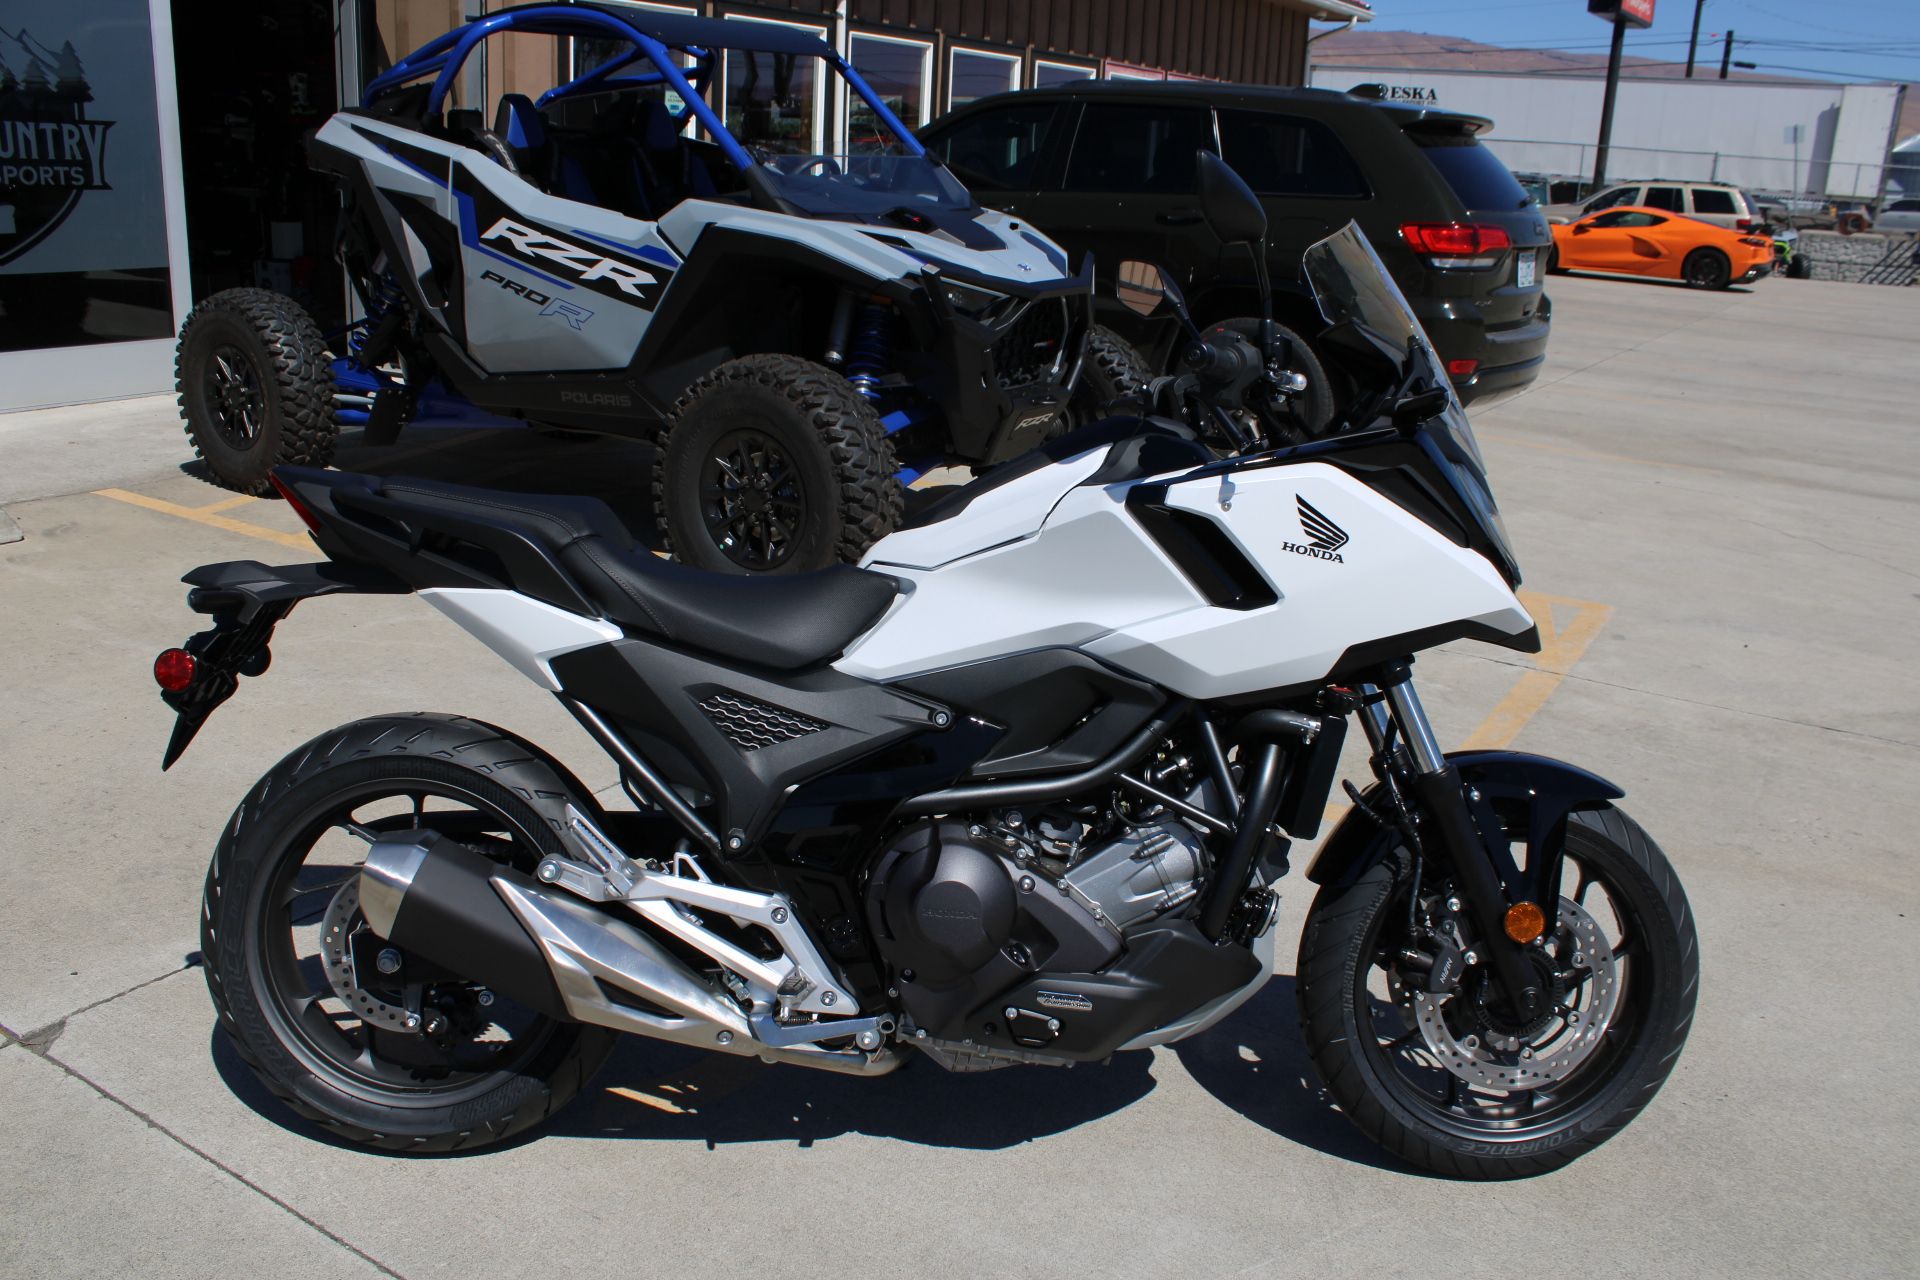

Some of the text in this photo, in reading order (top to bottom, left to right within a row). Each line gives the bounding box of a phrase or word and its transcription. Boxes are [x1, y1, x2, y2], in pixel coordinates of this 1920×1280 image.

[0, 164, 85, 186] PORTS
[480, 217, 658, 299] RZR
[480, 270, 595, 331] PRO R
[560, 391, 632, 407] POLARIS
[1281, 541, 1344, 564] HONDA
[1458, 1125, 1578, 1156] TOURANCE
